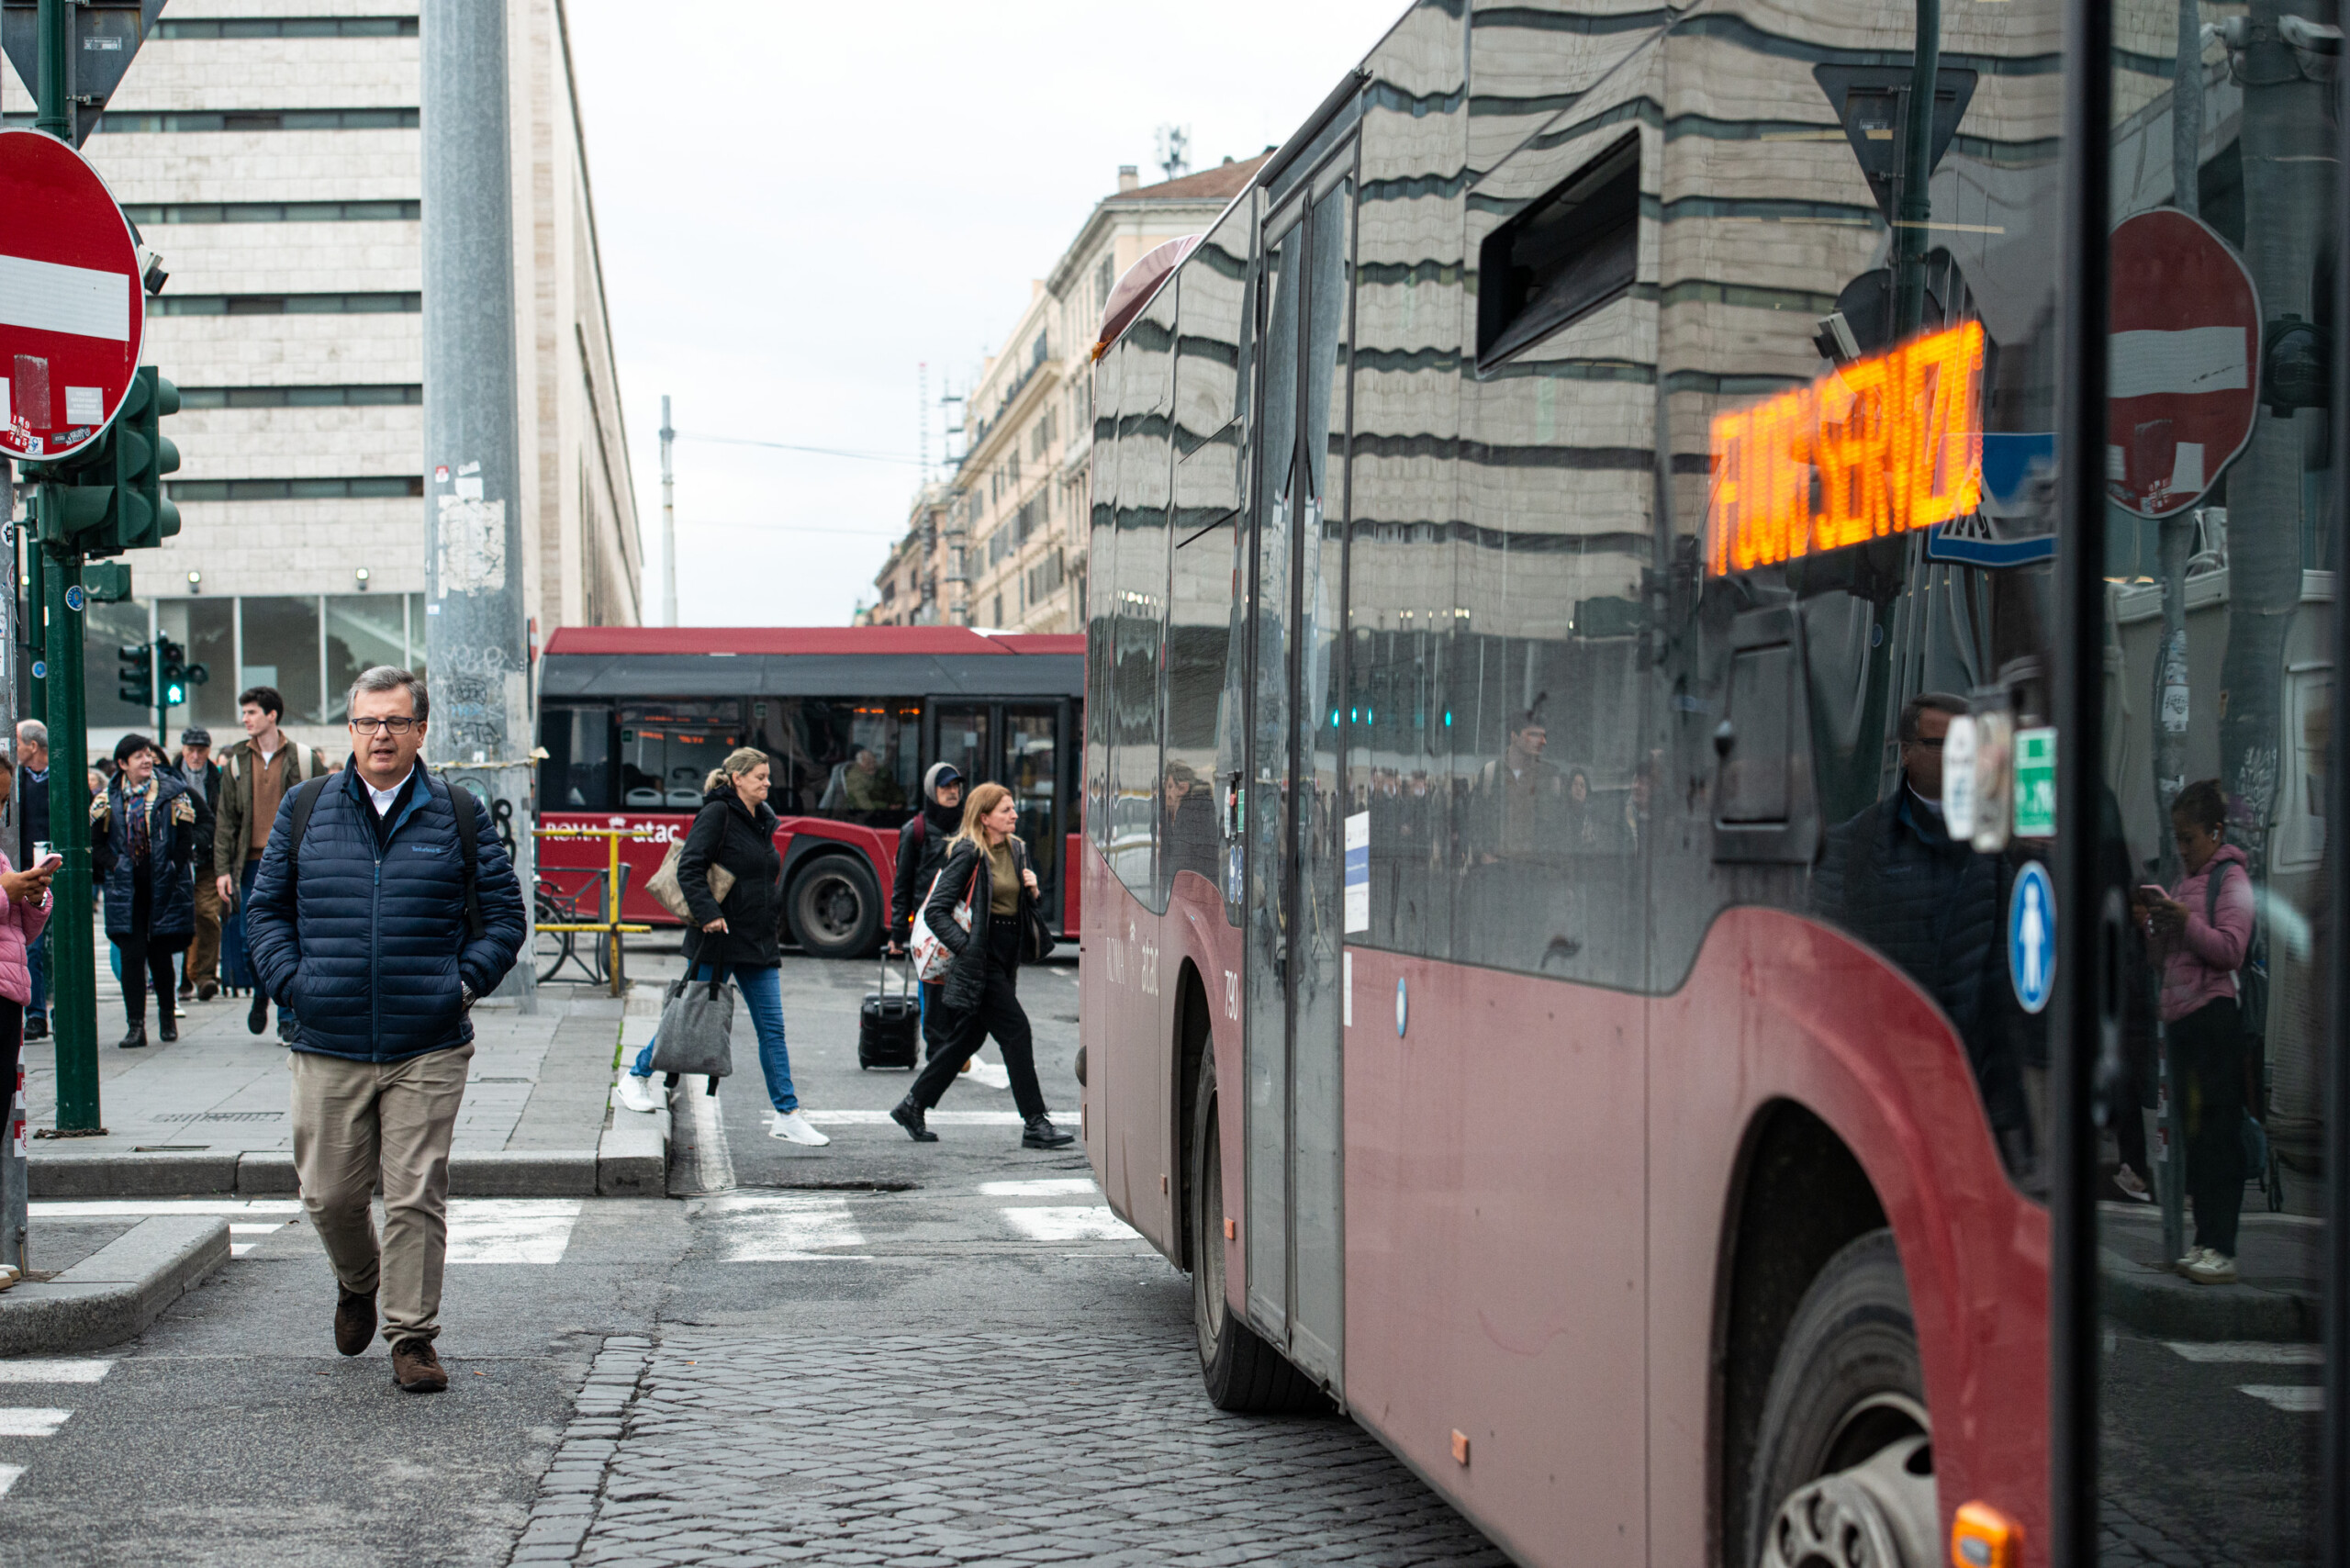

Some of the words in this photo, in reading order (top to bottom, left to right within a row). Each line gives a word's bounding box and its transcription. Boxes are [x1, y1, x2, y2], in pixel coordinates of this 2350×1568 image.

[632, 820, 680, 843] atac
[1141, 935, 1158, 997] atac
[1225, 969, 1238, 1021] 790
